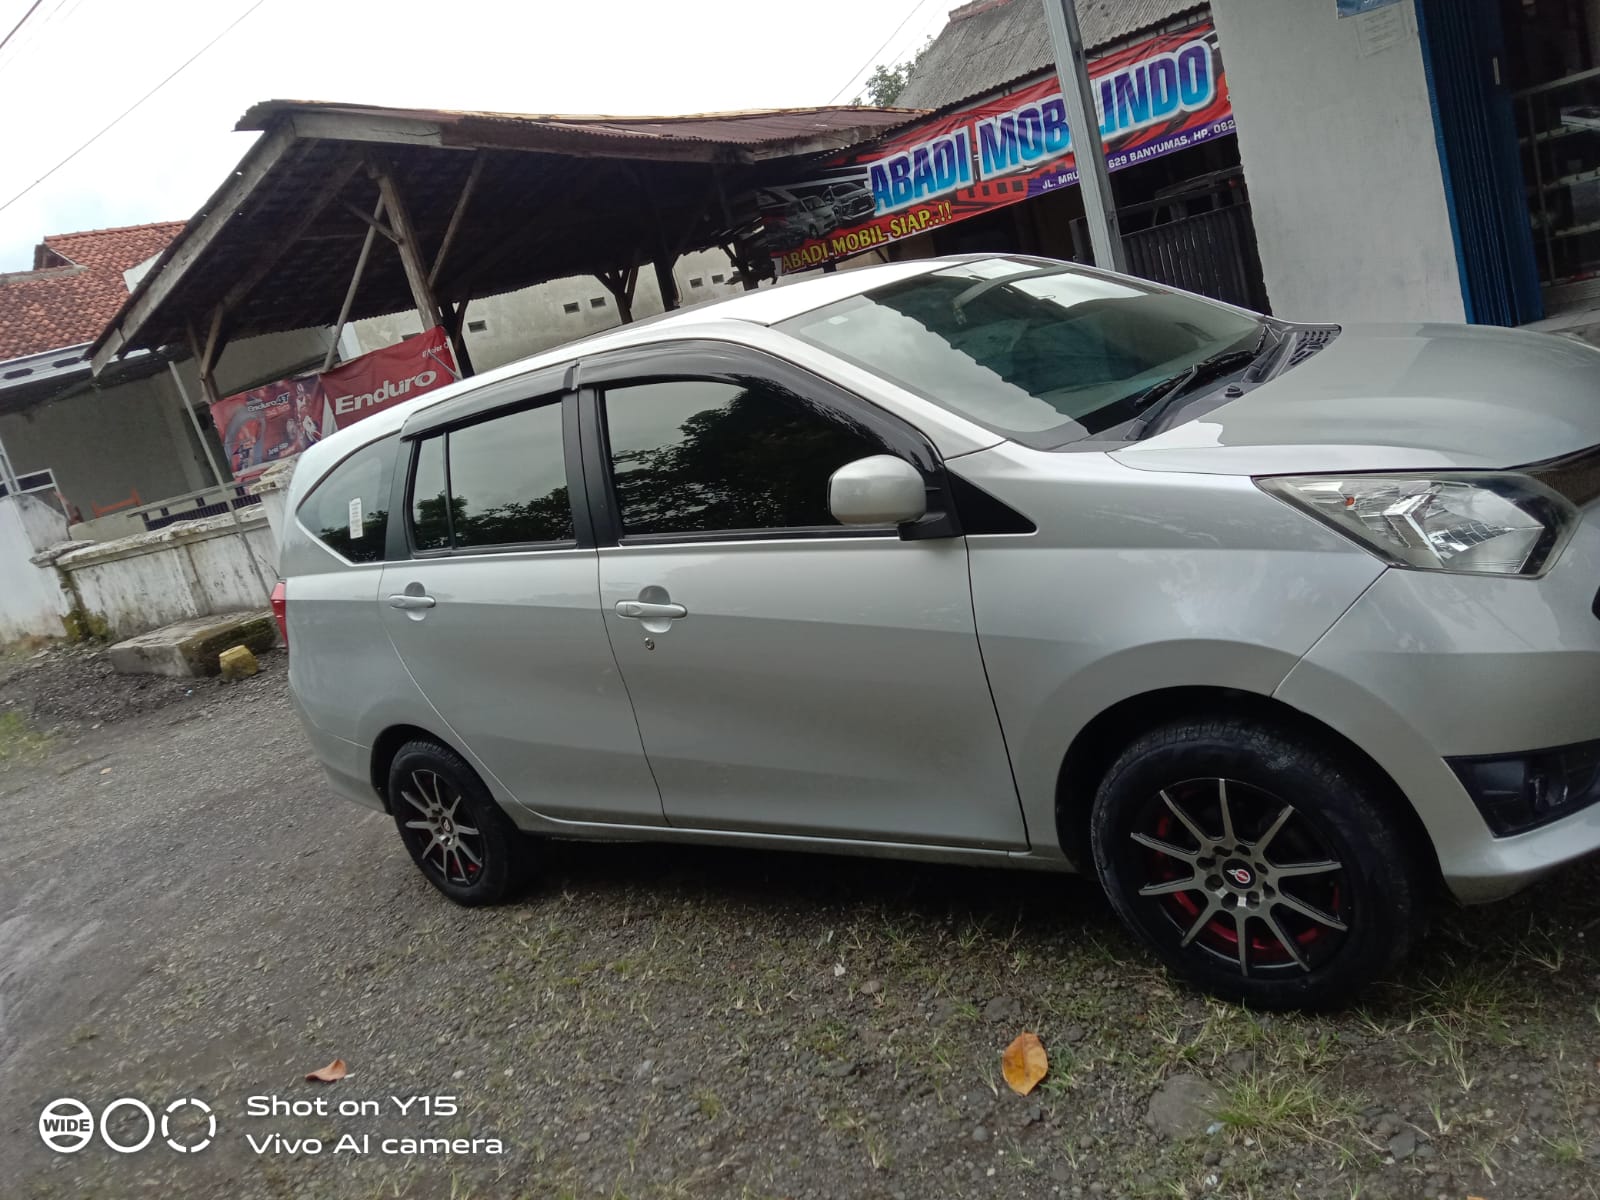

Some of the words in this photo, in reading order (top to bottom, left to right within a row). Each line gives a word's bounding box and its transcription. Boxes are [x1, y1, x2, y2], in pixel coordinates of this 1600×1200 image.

[869, 130, 972, 213] ABADI
[1042, 179, 1056, 190] JL.
[1108, 155, 1127, 168] 629
[1129, 135, 1191, 161] BANYUMAS,
[1193, 128, 1211, 141] HP.
[782, 243, 829, 273] ABADI
[832, 224, 888, 255] MOBIL
[335, 370, 437, 415] Enduro
